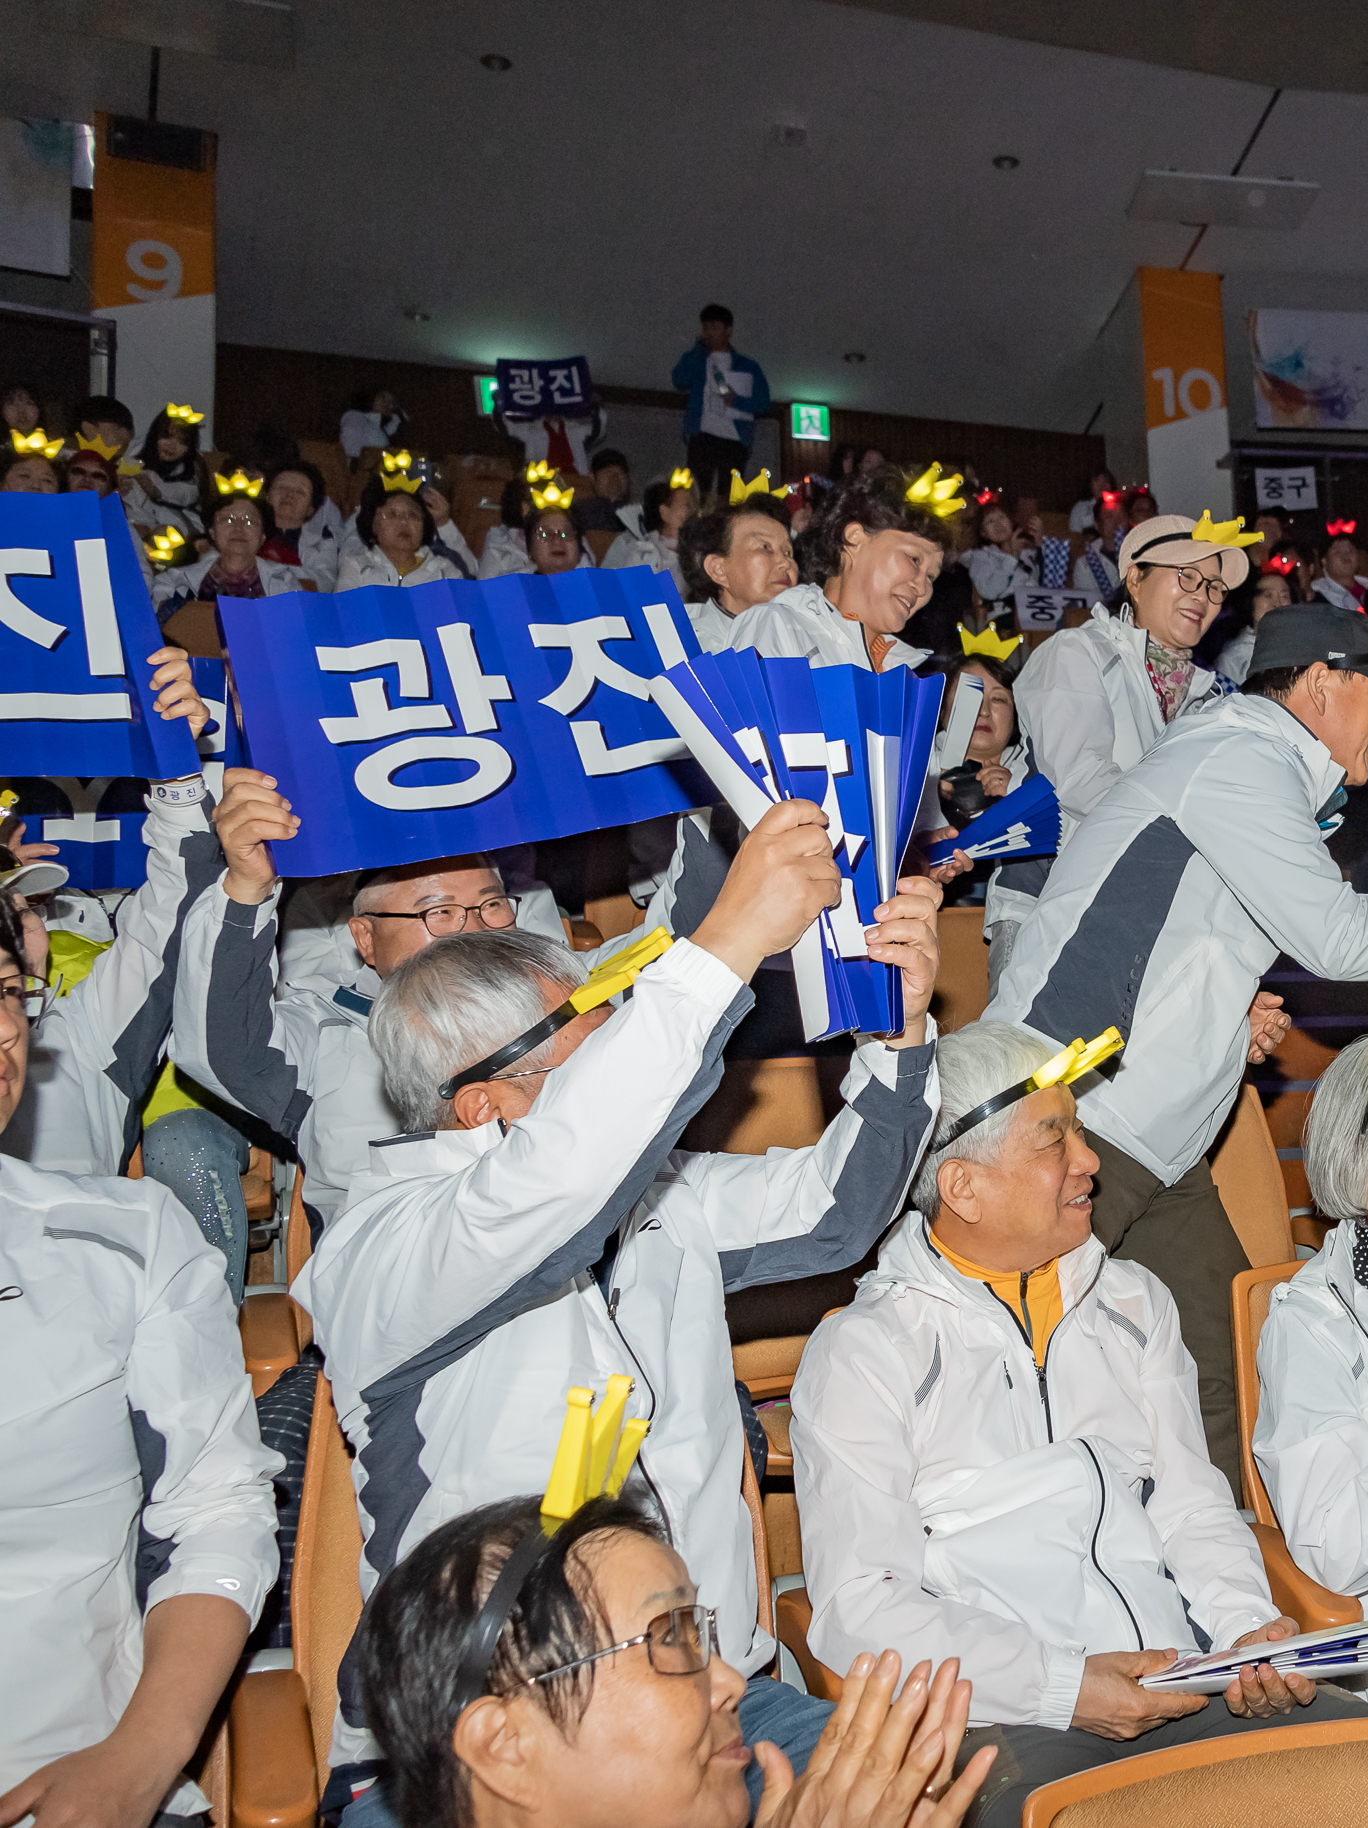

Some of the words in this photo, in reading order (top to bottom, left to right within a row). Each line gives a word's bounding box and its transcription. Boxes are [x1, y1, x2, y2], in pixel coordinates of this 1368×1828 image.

[126, 239, 183, 302] 9
[508, 366, 583, 406] 광진
[1152, 366, 1222, 419] 10
[1262, 476, 1310, 499] 중구
[315, 602, 697, 811] 광진
